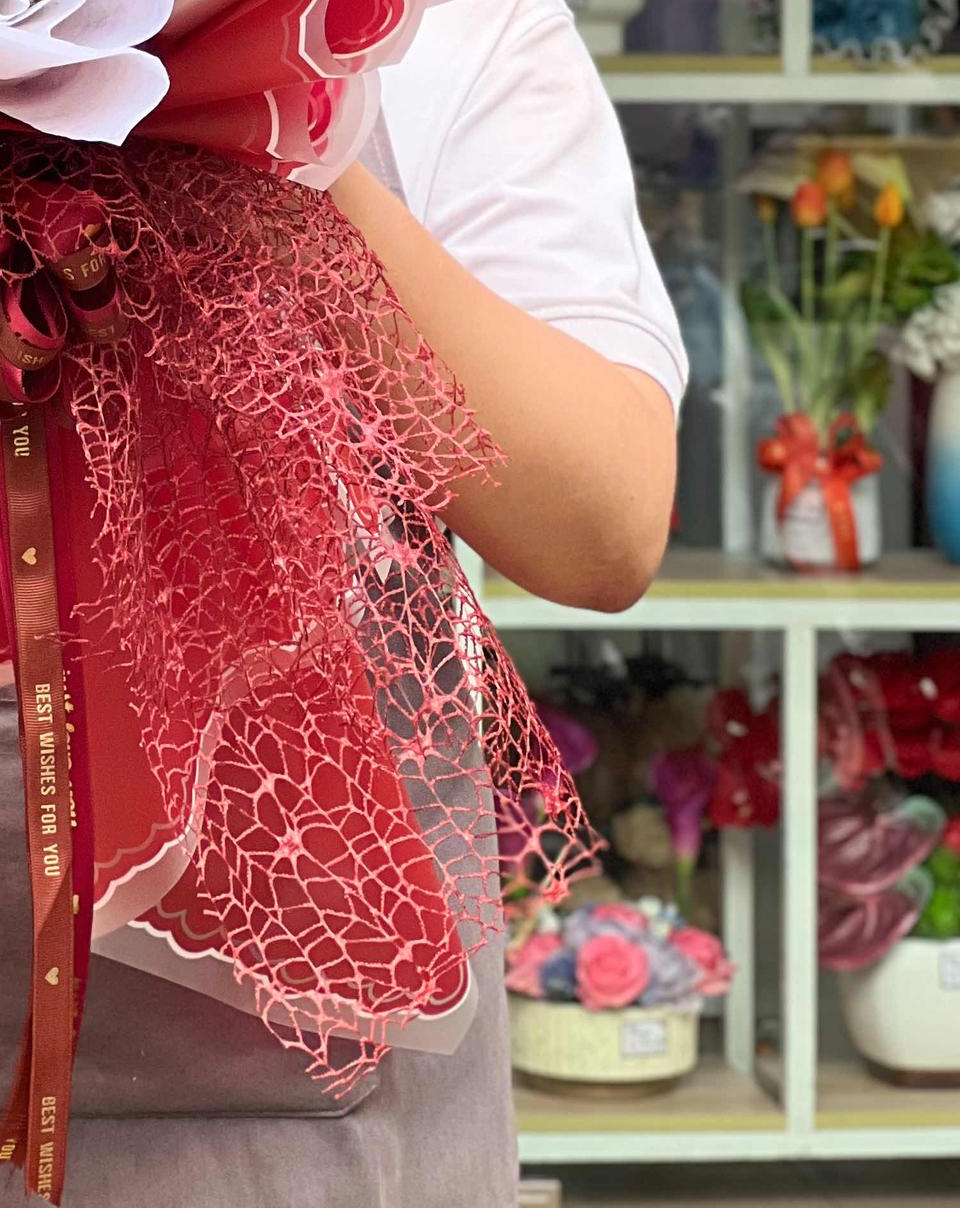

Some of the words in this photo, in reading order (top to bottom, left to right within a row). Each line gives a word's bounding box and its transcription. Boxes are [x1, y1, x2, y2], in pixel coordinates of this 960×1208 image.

[12, 425, 30, 457] YOU
[35, 683, 53, 723] BEST
[39, 732, 56, 796] WISHES
[40, 805, 57, 835] FOR
[43, 844, 61, 877] YOU
[41, 1096, 56, 1134] BEST
[37, 1141, 54, 1201] WISHES
